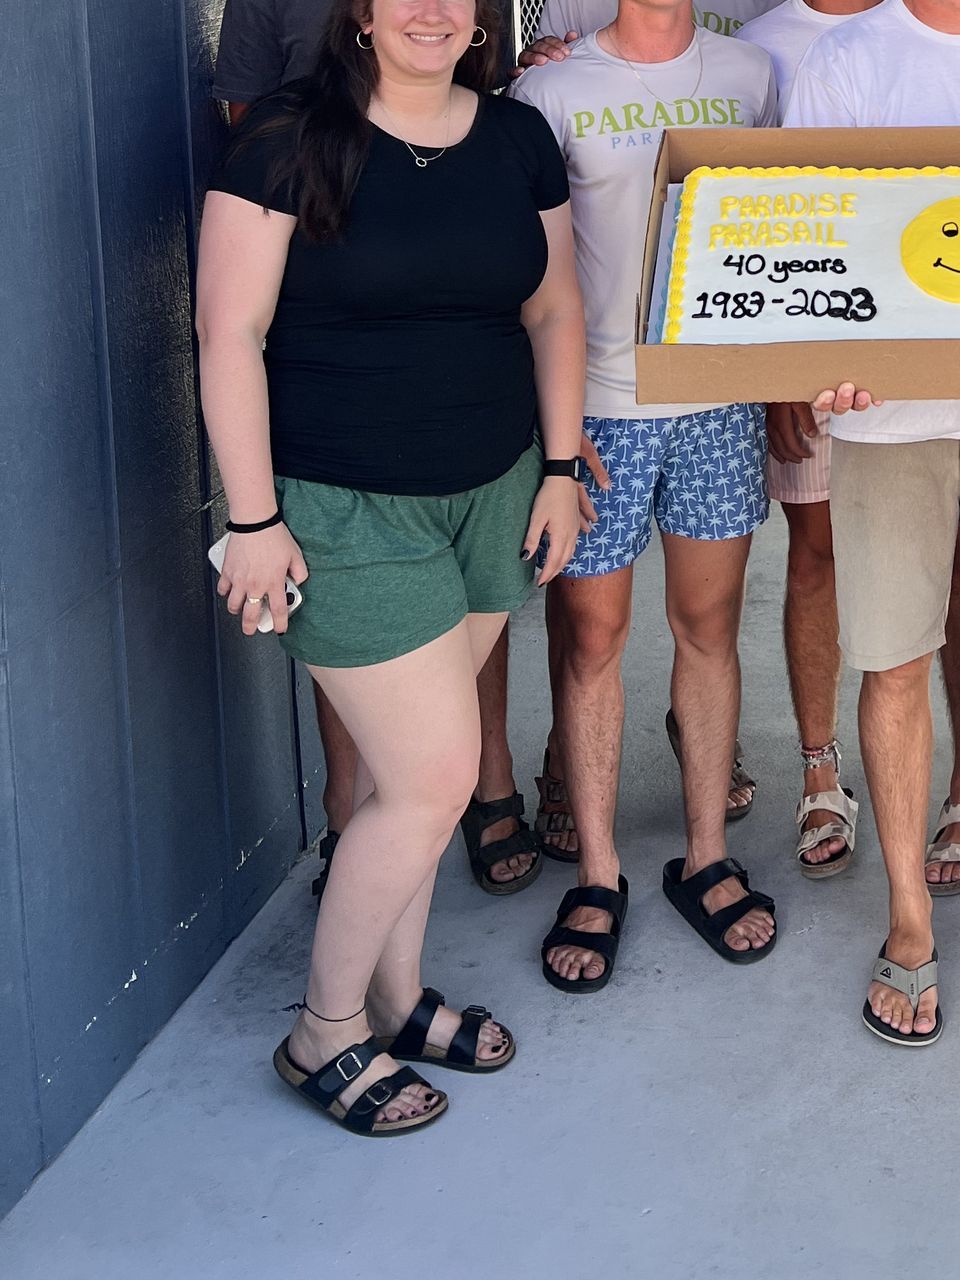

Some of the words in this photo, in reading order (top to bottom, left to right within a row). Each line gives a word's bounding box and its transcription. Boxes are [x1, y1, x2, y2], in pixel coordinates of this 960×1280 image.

[572, 97, 745, 138] PARADISE
[719, 192, 858, 220] PARADISE
[708, 221, 849, 251] PARASAIL
[723, 254, 766, 276] 40
[767, 258, 847, 283] years
